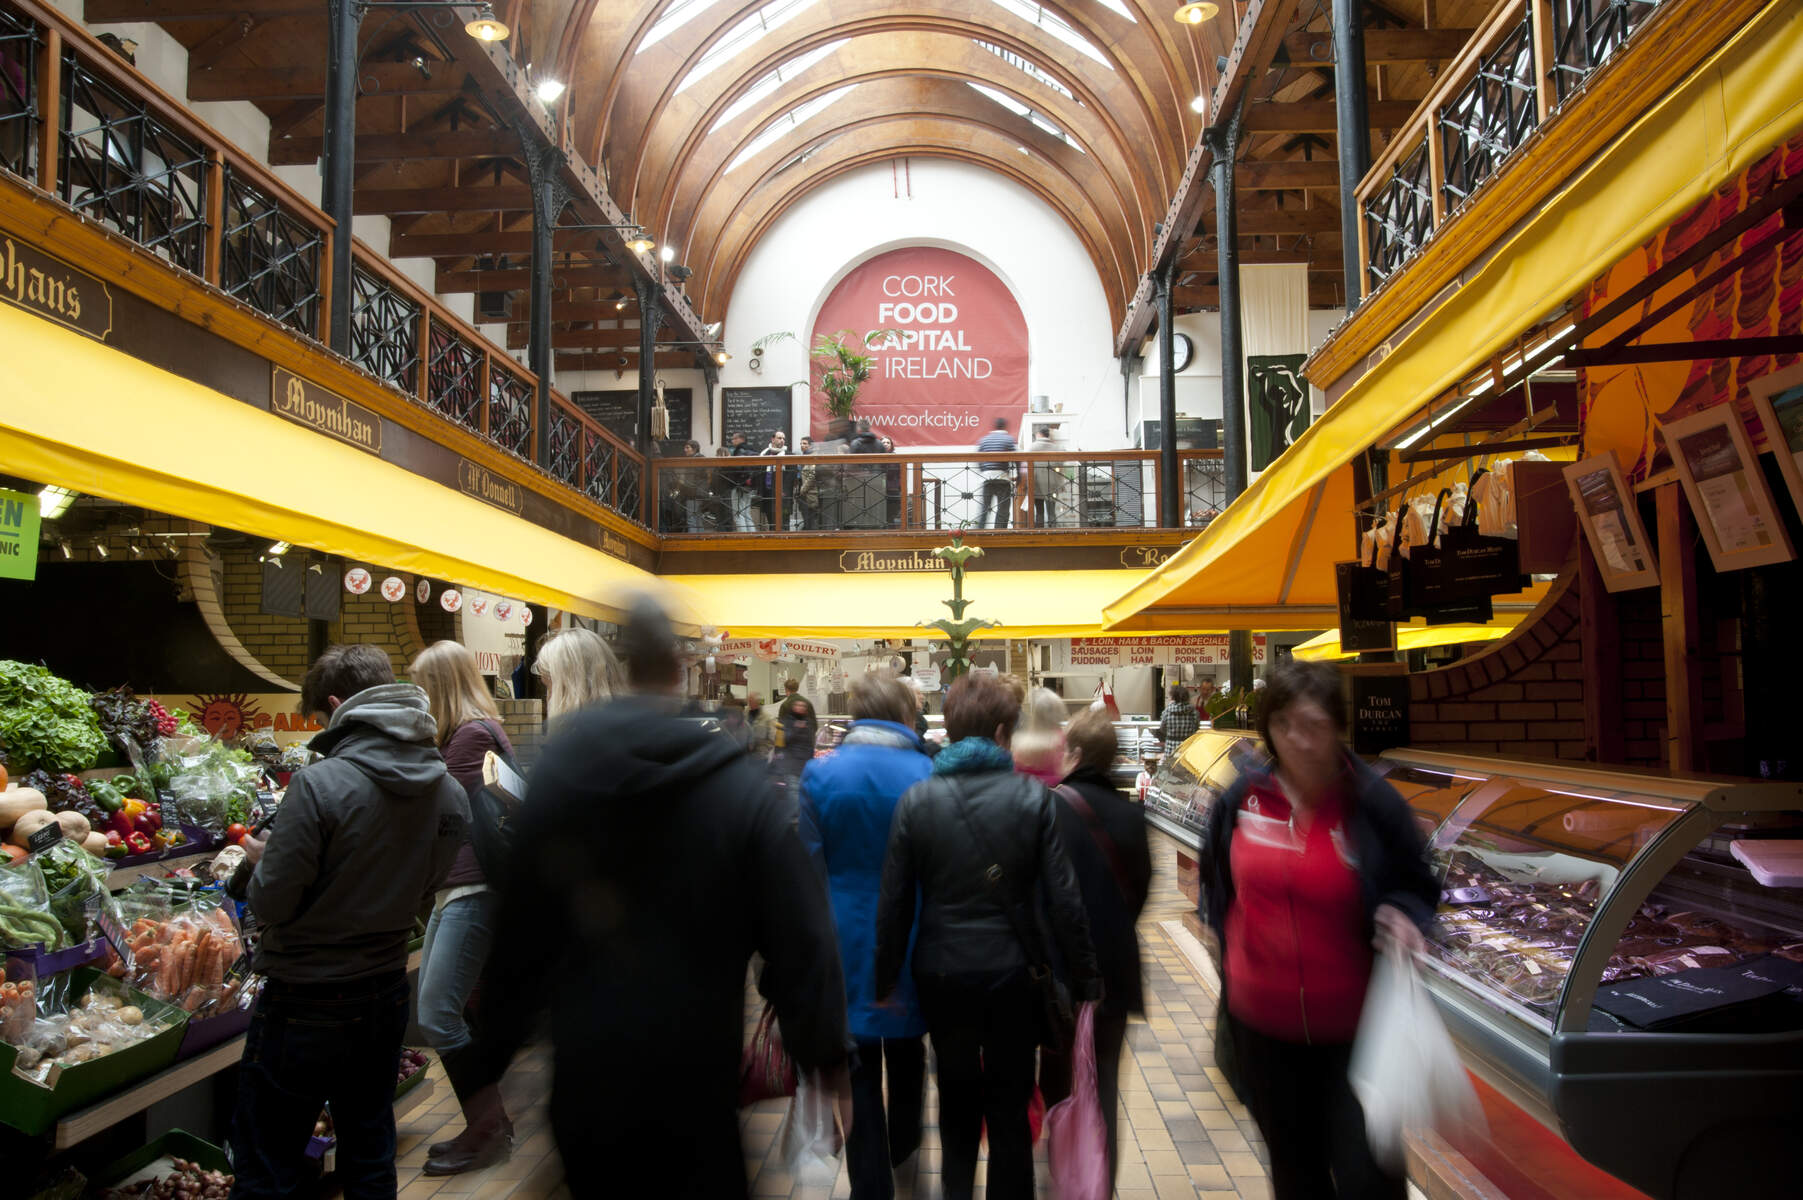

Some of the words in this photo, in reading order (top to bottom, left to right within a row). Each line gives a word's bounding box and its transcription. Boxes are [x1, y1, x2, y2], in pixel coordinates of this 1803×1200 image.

[0, 239, 81, 320] han's
[882, 275, 956, 297] CORK
[878, 302, 959, 324] FOOD
[863, 329, 972, 351] CAPITAL
[885, 357, 993, 379] IRELAND
[281, 377, 372, 446] Moynihan
[0, 498, 24, 527] N
[854, 551, 945, 571] Moynihan
[786, 641, 838, 656] POULTRY
[1119, 637, 1140, 646] HAM
[1142, 637, 1148, 645] &
[1150, 636, 1183, 645] BACON
[1071, 646, 1119, 656] SAUSAGES
[1130, 646, 1155, 655] LOIN
[1071, 655, 1111, 665] PUDDING
[1130, 655, 1154, 664] HAM
[1174, 655, 1198, 664] PORK
[1199, 655, 1213, 664] RIB
[1359, 709, 1402, 720] DURCAN
